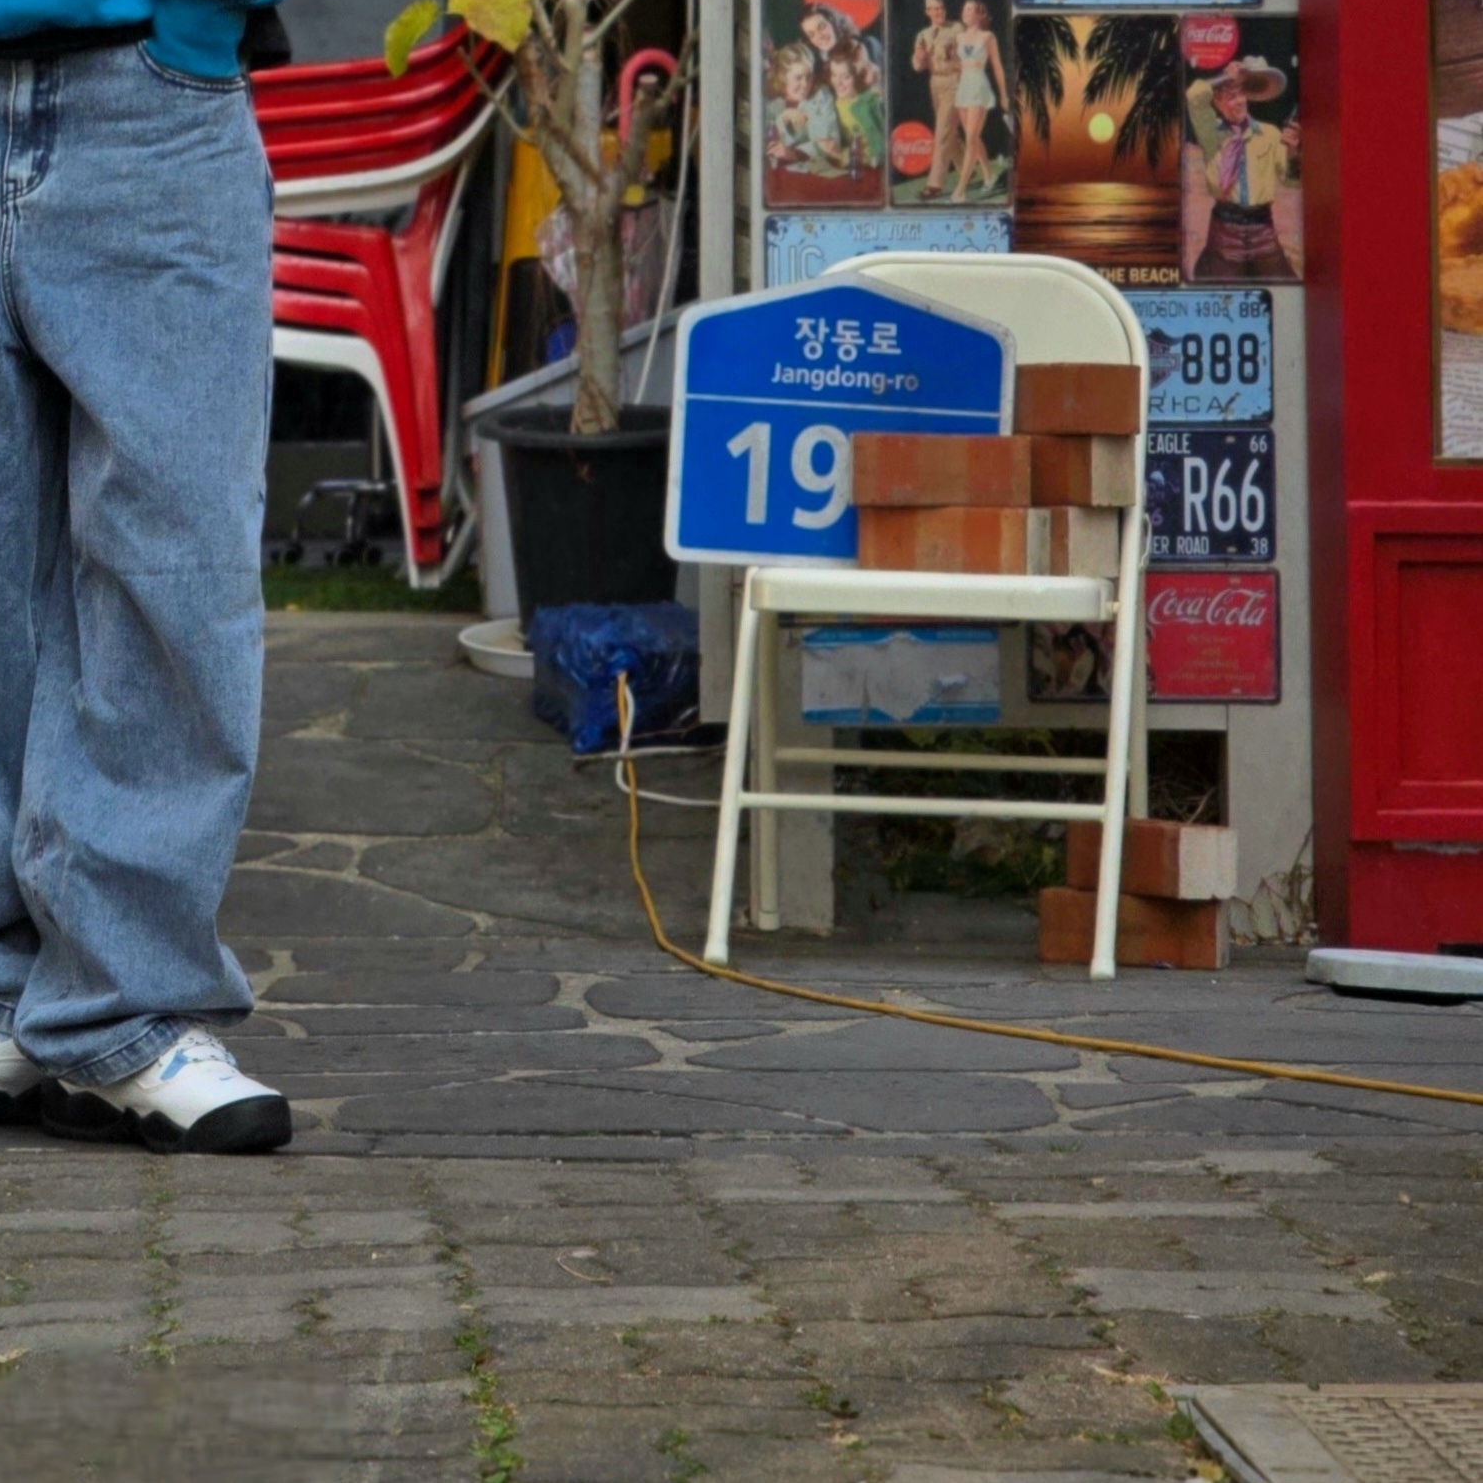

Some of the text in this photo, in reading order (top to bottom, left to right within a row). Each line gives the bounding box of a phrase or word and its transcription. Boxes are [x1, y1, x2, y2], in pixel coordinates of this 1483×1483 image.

[1129, 267, 1180, 283] BEACH
[794, 317, 902, 362] 장동로
[1181, 332, 1260, 385] 888
[770, 363, 919, 394] Jangdong-ro
[1147, 433, 1268, 455] EAGLE 66
[725, 421, 853, 530] 19
[1183, 456, 1266, 533] R66
[1176, 536, 1210, 555] ROAD
[1250, 537, 1269, 556] 38
[1147, 587, 1268, 627] Coca-Cola
